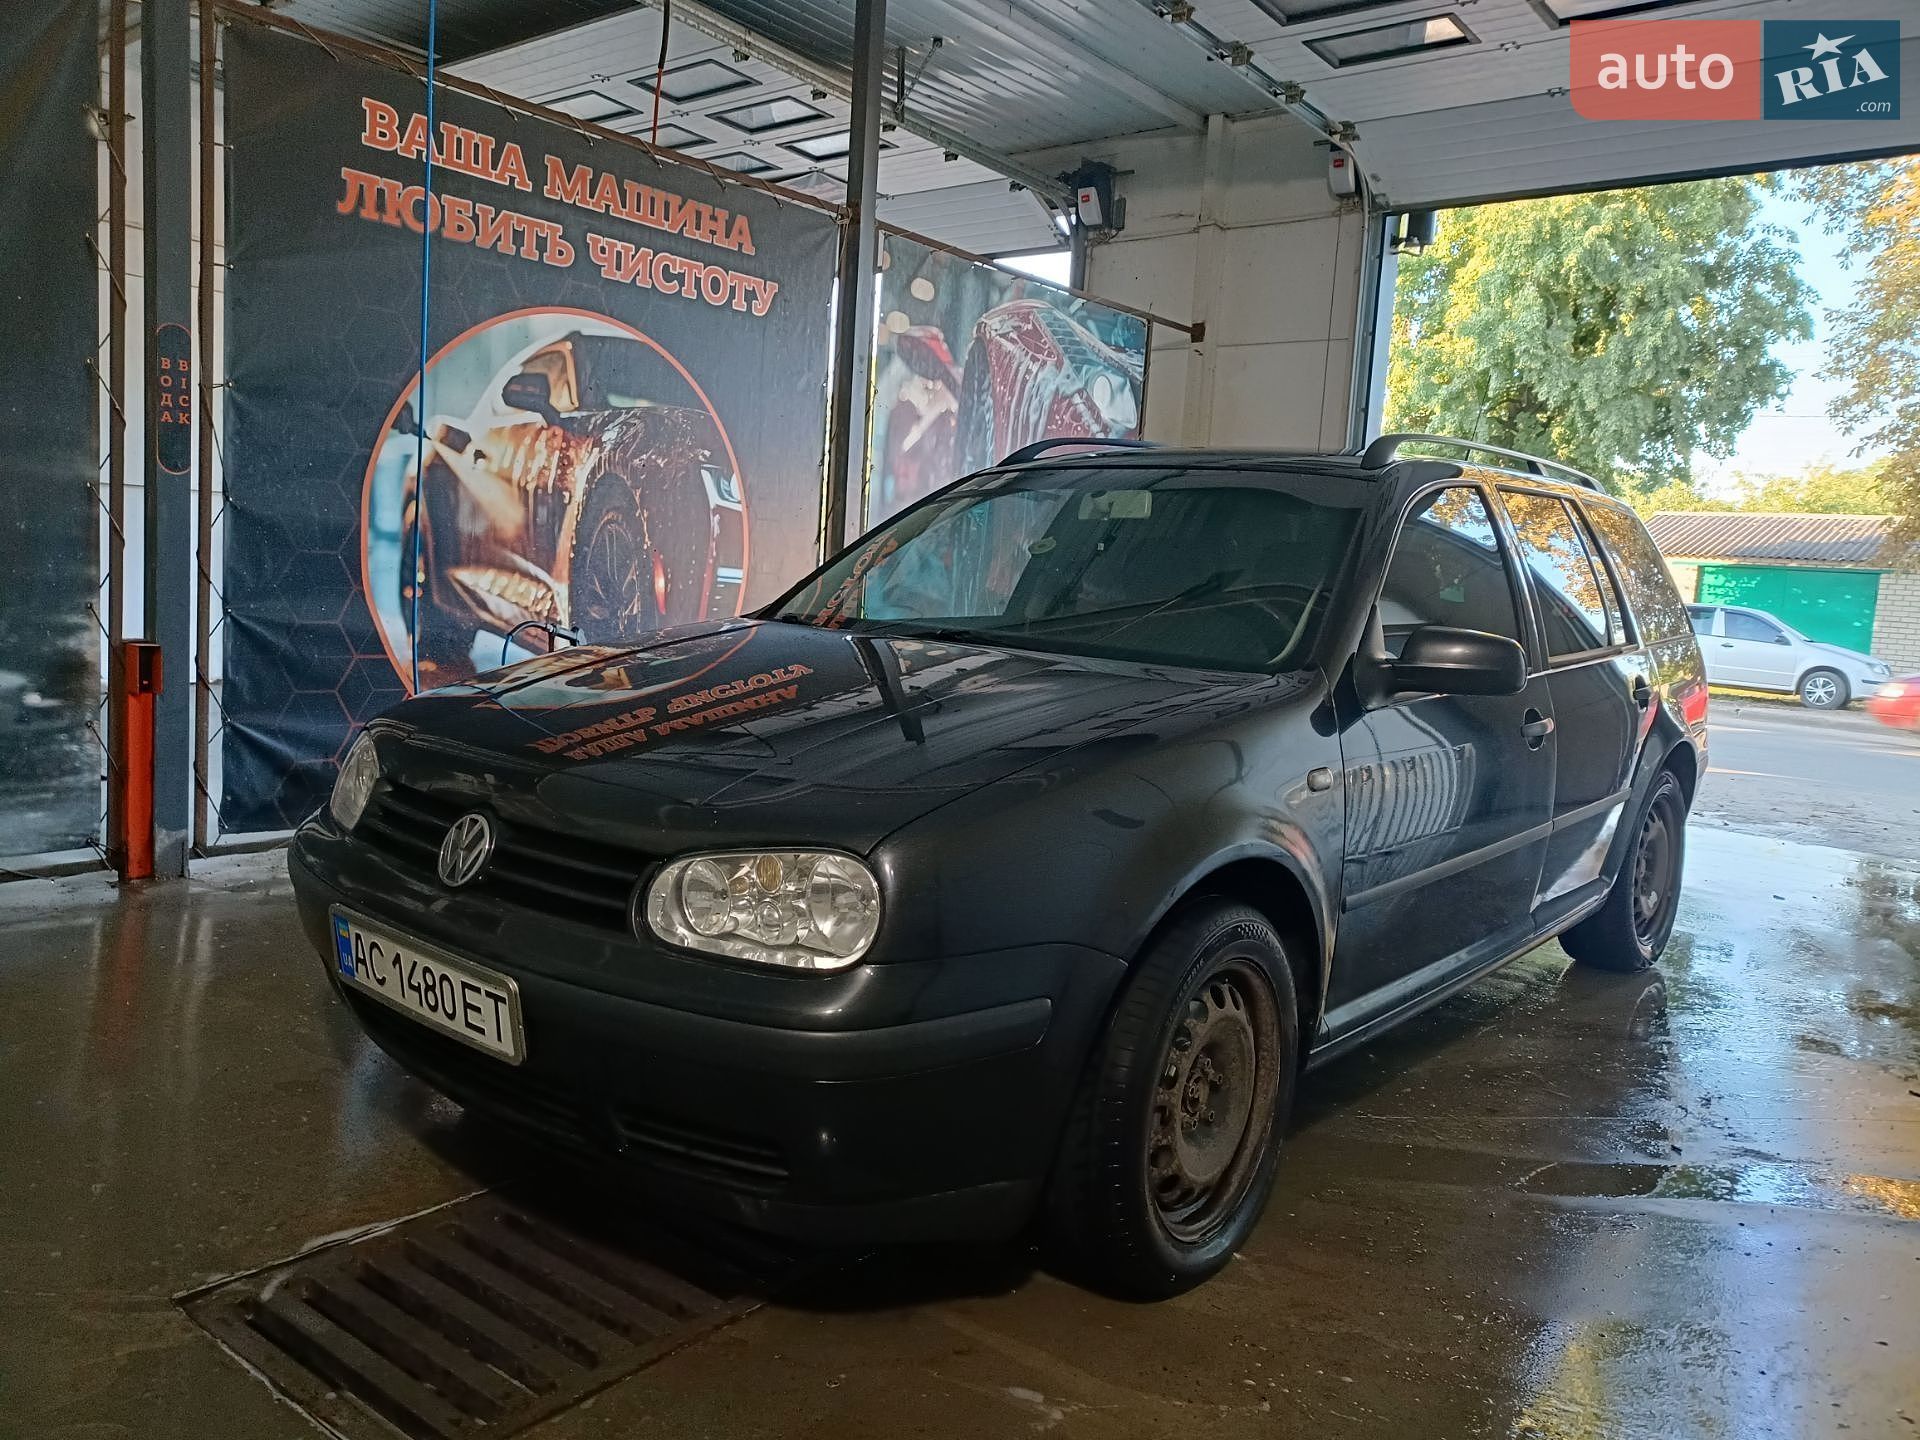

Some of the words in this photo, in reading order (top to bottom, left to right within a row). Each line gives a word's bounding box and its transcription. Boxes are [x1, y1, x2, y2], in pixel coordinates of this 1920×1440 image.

[362, 97, 532, 192] ВАША
[543, 154, 756, 256] МАШИНА
[337, 167, 576, 268] ЛЮБИТЬ
[587, 233, 779, 317] ЧИСТОТУ
[160, 357, 173, 423] ВОДА
[178, 359, 190, 425] ВІСК
[354, 931, 387, 987] AC
[391, 951, 457, 1022] 1480
[460, 979, 508, 1044] ET
